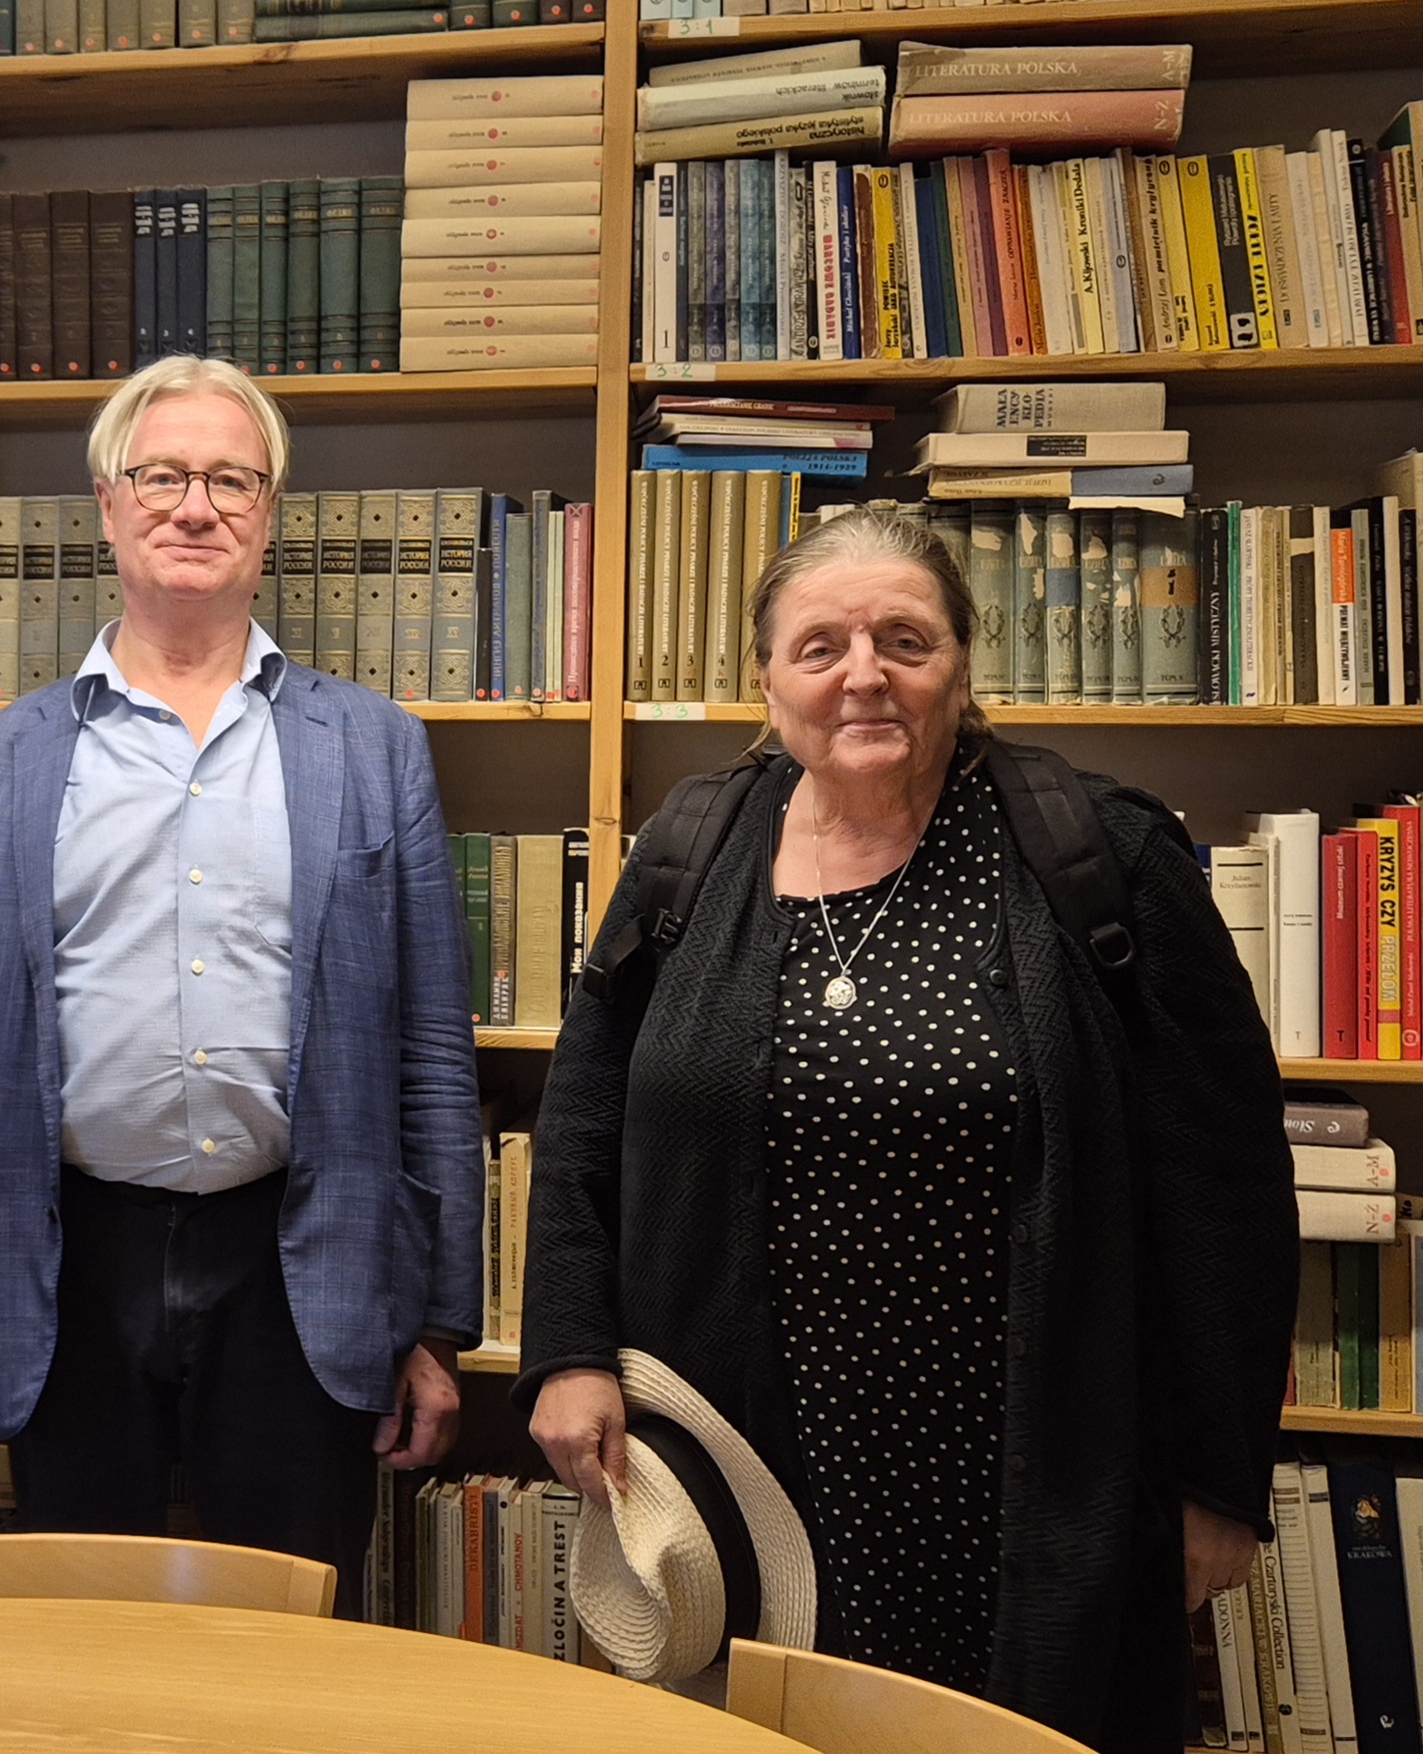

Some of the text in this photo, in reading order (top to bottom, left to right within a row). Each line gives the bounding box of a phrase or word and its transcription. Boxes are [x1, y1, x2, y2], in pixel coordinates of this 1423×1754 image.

[680, 19, 714, 35] 3:1
[915, 62, 1078, 77] LITERATURA POLSKA
[841, 91, 879, 102] słownik
[818, 116, 864, 130] stylistyka
[908, 110, 1073, 123] LITERATURA POLSKA
[736, 125, 783, 140] polskiego
[809, 126, 865, 140] historyczna
[1072, 163, 1087, 236] Kroniki Dedala
[655, 364, 693, 378] 3:2
[996, 388, 1007, 428] MAŁA
[1009, 390, 1020, 426] ENCY
[1022, 394, 1032, 422] KLO
[1034, 388, 1045, 428] PEDIA
[637, 657, 644, 668] 1
[661, 655, 669, 666] 2
[686, 656, 694, 667] 3
[717, 655, 726, 666] 4
[651, 702, 691, 720] 3:3
[574, 882, 584, 943] показания
[1380, 836, 1396, 1002] KRYZYS CZY PRZEŁOM
[1336, 1029, 1345, 1042] T
[1366, 1155, 1380, 1187] A-M
[515, 1532, 523, 1591] CHMOTANOV
[550, 1520, 565, 1661] ZLOČIN A TREST
[1263, 1556, 1287, 1669] Czartoryski Collection
